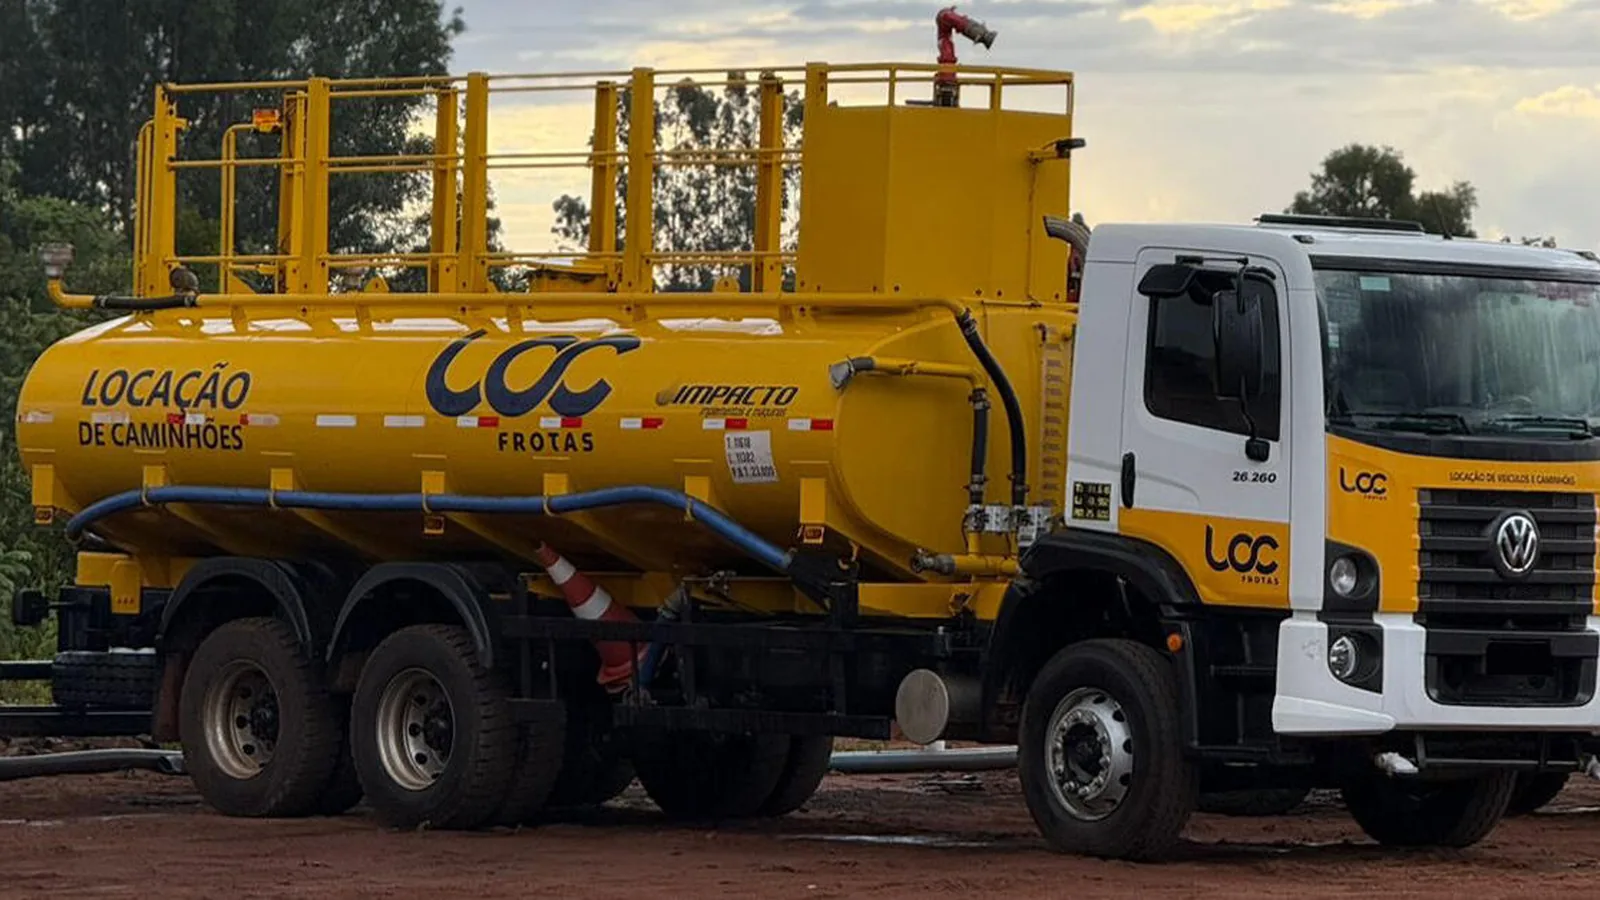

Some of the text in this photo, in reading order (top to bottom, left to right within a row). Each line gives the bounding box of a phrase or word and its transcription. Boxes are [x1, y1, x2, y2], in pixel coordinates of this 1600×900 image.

[426, 328, 641, 417] LOC
[82, 362, 251, 414] LOCAÇÃO
[673, 385, 799, 406] IMPACTO
[79, 418, 244, 450] DE CAMINHÕES
[498, 432, 594, 452] FROTAS
[1340, 467, 1387, 495] LOC
[1205, 524, 1280, 575] LOC
[1241, 574, 1280, 586] FROTAS
